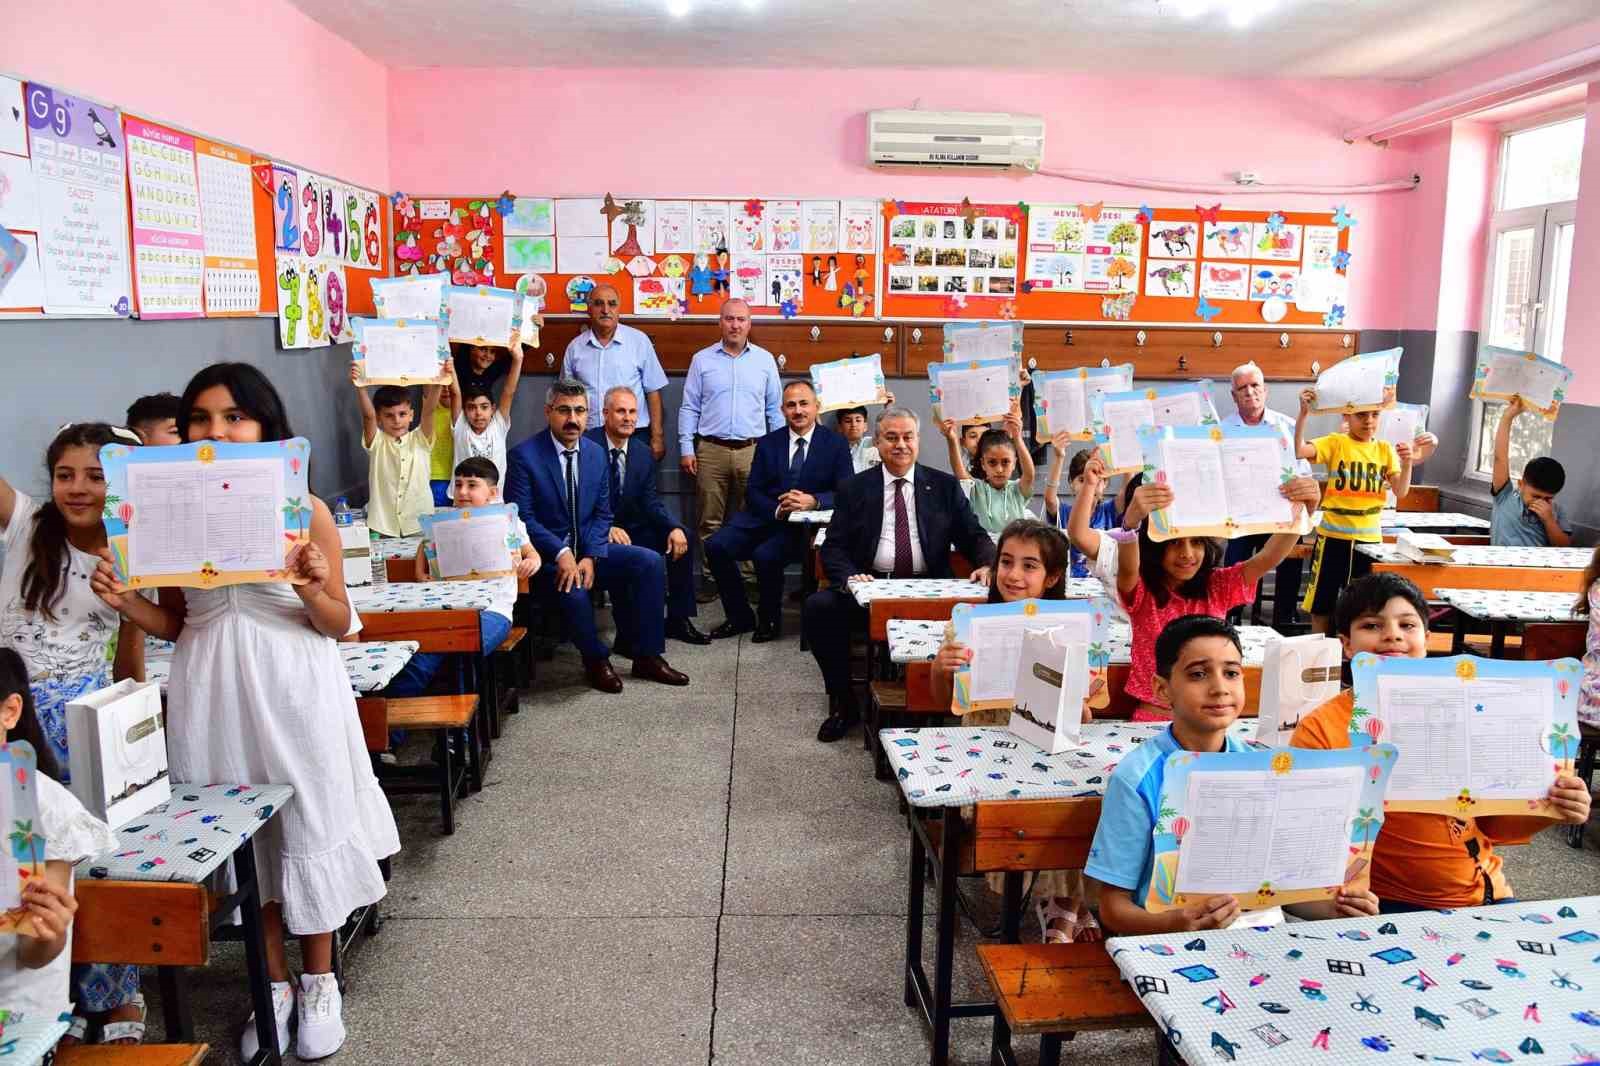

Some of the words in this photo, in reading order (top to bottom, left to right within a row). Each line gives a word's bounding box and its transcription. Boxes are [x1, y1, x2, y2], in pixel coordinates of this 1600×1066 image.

[277, 178, 298, 248] 2
[303, 182, 320, 257] 3
[324, 188, 342, 255] 4
[346, 195, 361, 263] 5
[364, 200, 380, 266] 6
[279, 270, 302, 346] 7
[307, 271, 324, 340] 8
[327, 271, 344, 337] 9
